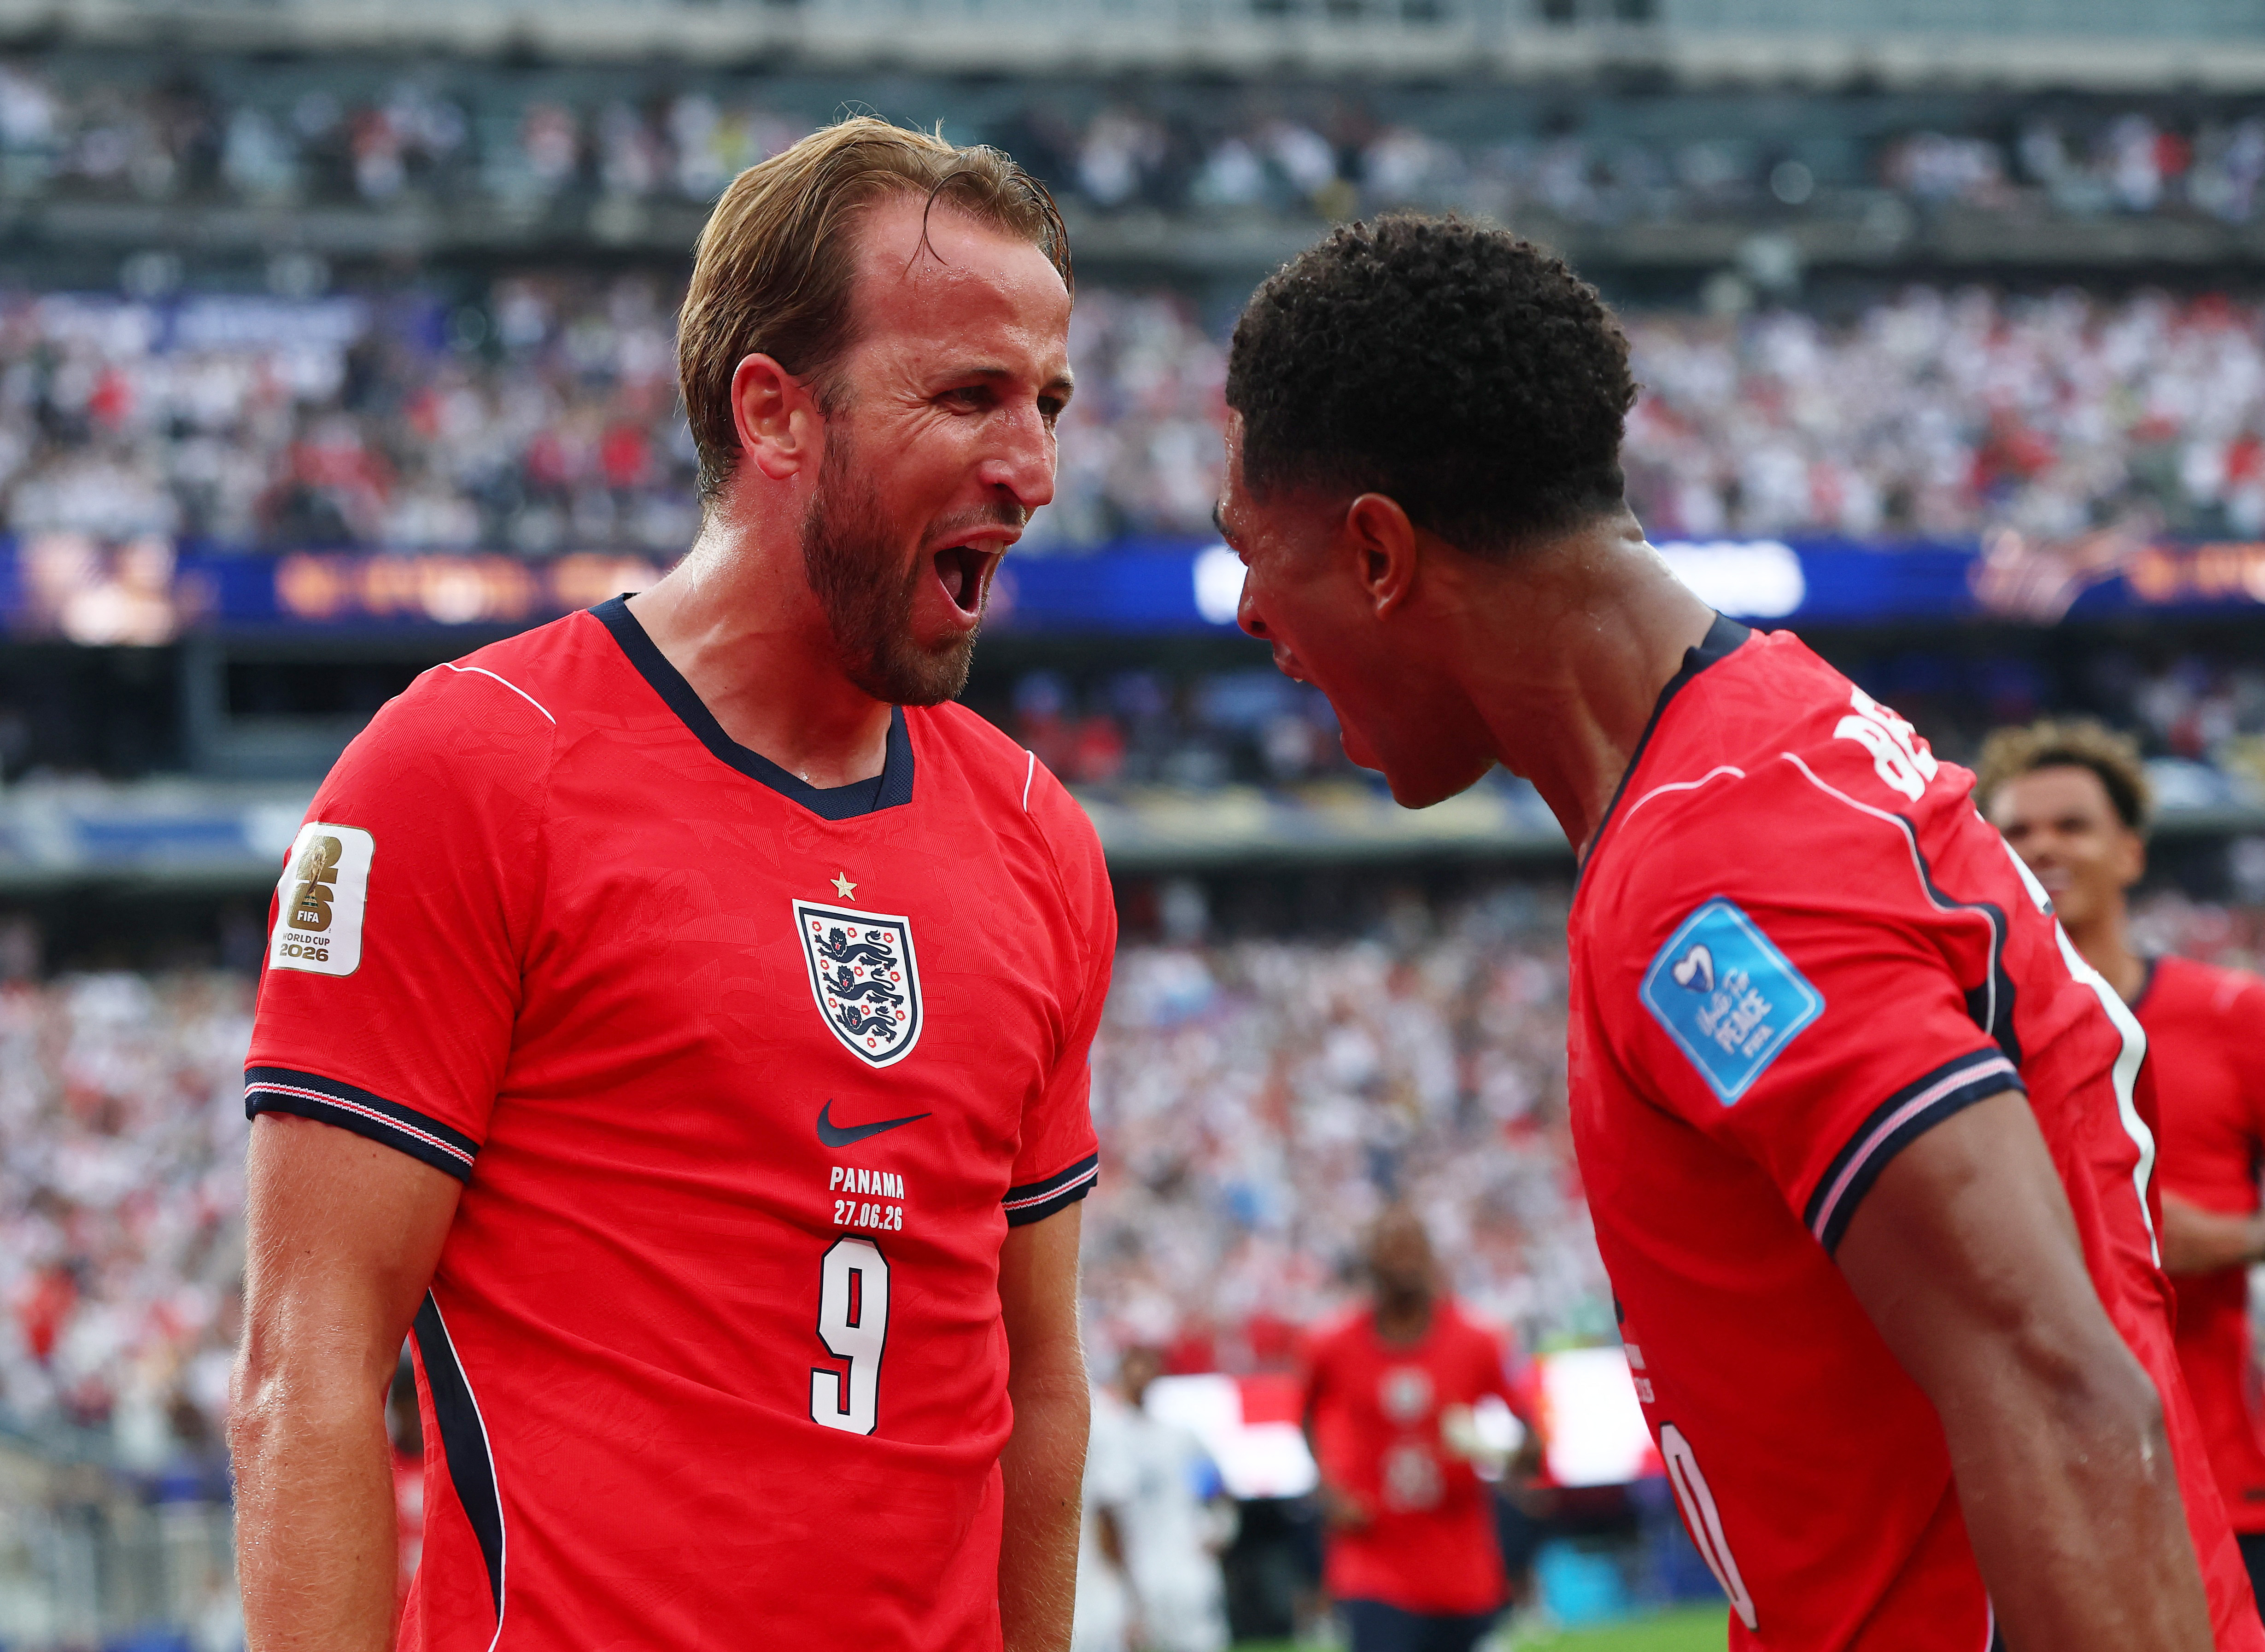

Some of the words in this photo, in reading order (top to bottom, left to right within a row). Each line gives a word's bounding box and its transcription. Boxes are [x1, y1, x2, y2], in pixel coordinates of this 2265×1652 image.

[297, 910, 319, 923] FIFA
[283, 933, 311, 943] WORLD
[313, 936, 330, 946] CUP
[279, 943, 328, 962] 2026
[829, 1166, 905, 1200] PANAMA
[833, 1199, 903, 1231] 27.06.26
[809, 1233, 891, 1436] 9
